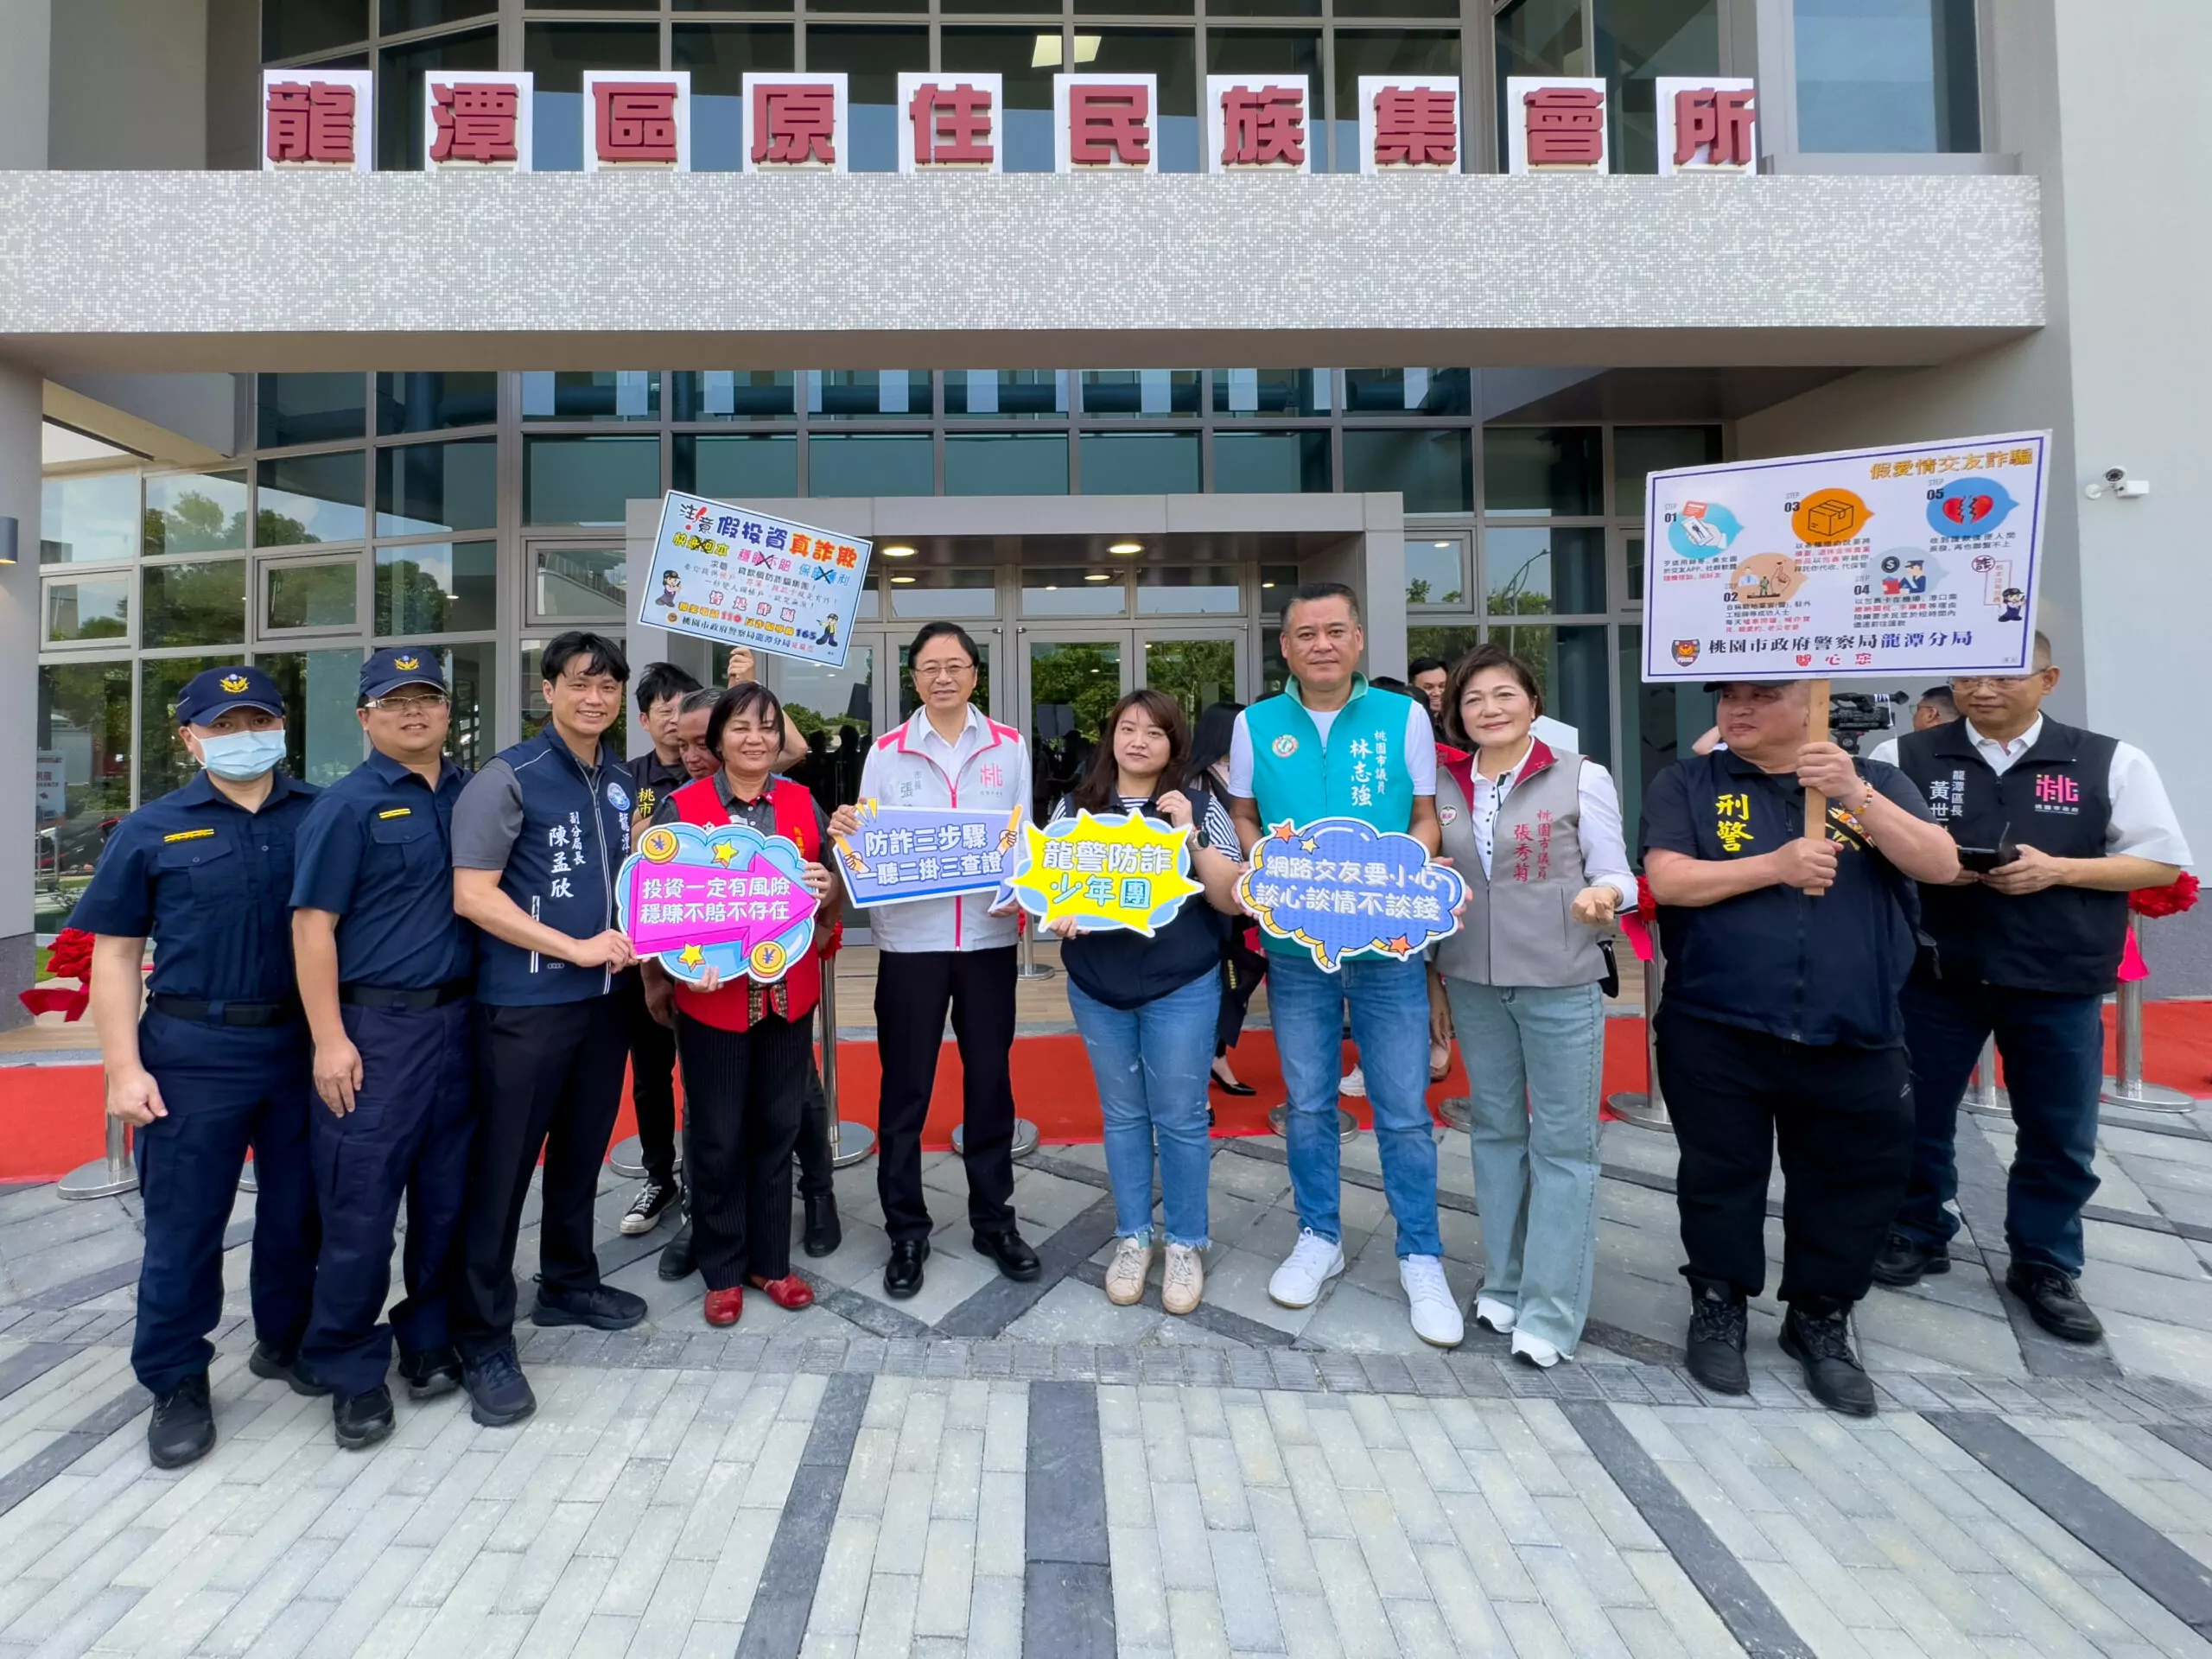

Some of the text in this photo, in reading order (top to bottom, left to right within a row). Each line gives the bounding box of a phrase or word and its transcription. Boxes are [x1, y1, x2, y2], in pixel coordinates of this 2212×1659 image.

[266, 81, 1755, 164] 龍潭區原住民族集會所
[1870, 448, 2033, 480] 假愛情交友詐騙
[1784, 502, 1801, 512] 03
[1927, 488, 1944, 500] 05
[1664, 512, 1677, 523] 01
[1975, 557, 1993, 570] 詐
[1724, 592, 1738, 602] 02
[1853, 585, 1870, 595] 04
[1708, 630, 1973, 654] 桃園市政府警察局龍潭分局
[1350, 738, 1373, 807] 林志強
[1374, 729, 1388, 796] 桃園市議員
[900, 781, 914, 806] 張
[1929, 780, 1950, 830] 黃世
[1950, 770, 1966, 817] 龍潭區長
[569, 811, 587, 866] 副分局長
[863, 823, 988, 857] 防詐三步驟
[1715, 793, 1754, 852] 刑警
[549, 825, 575, 899] 陳孟欣
[1042, 840, 1173, 874] 龍警防詐
[1513, 823, 1534, 884] 張秀菊
[1537, 809, 1553, 880] 桃園市議員
[855, 851, 1003, 886] 一聽二掛三查證
[1265, 855, 1444, 891] 網路交友要小心
[642, 877, 791, 899] 投資一定有風險
[1051, 873, 1152, 909] 少年團
[1255, 882, 1441, 922] 談心談情不談錢
[640, 900, 791, 925] 穩賺不賠不存在
